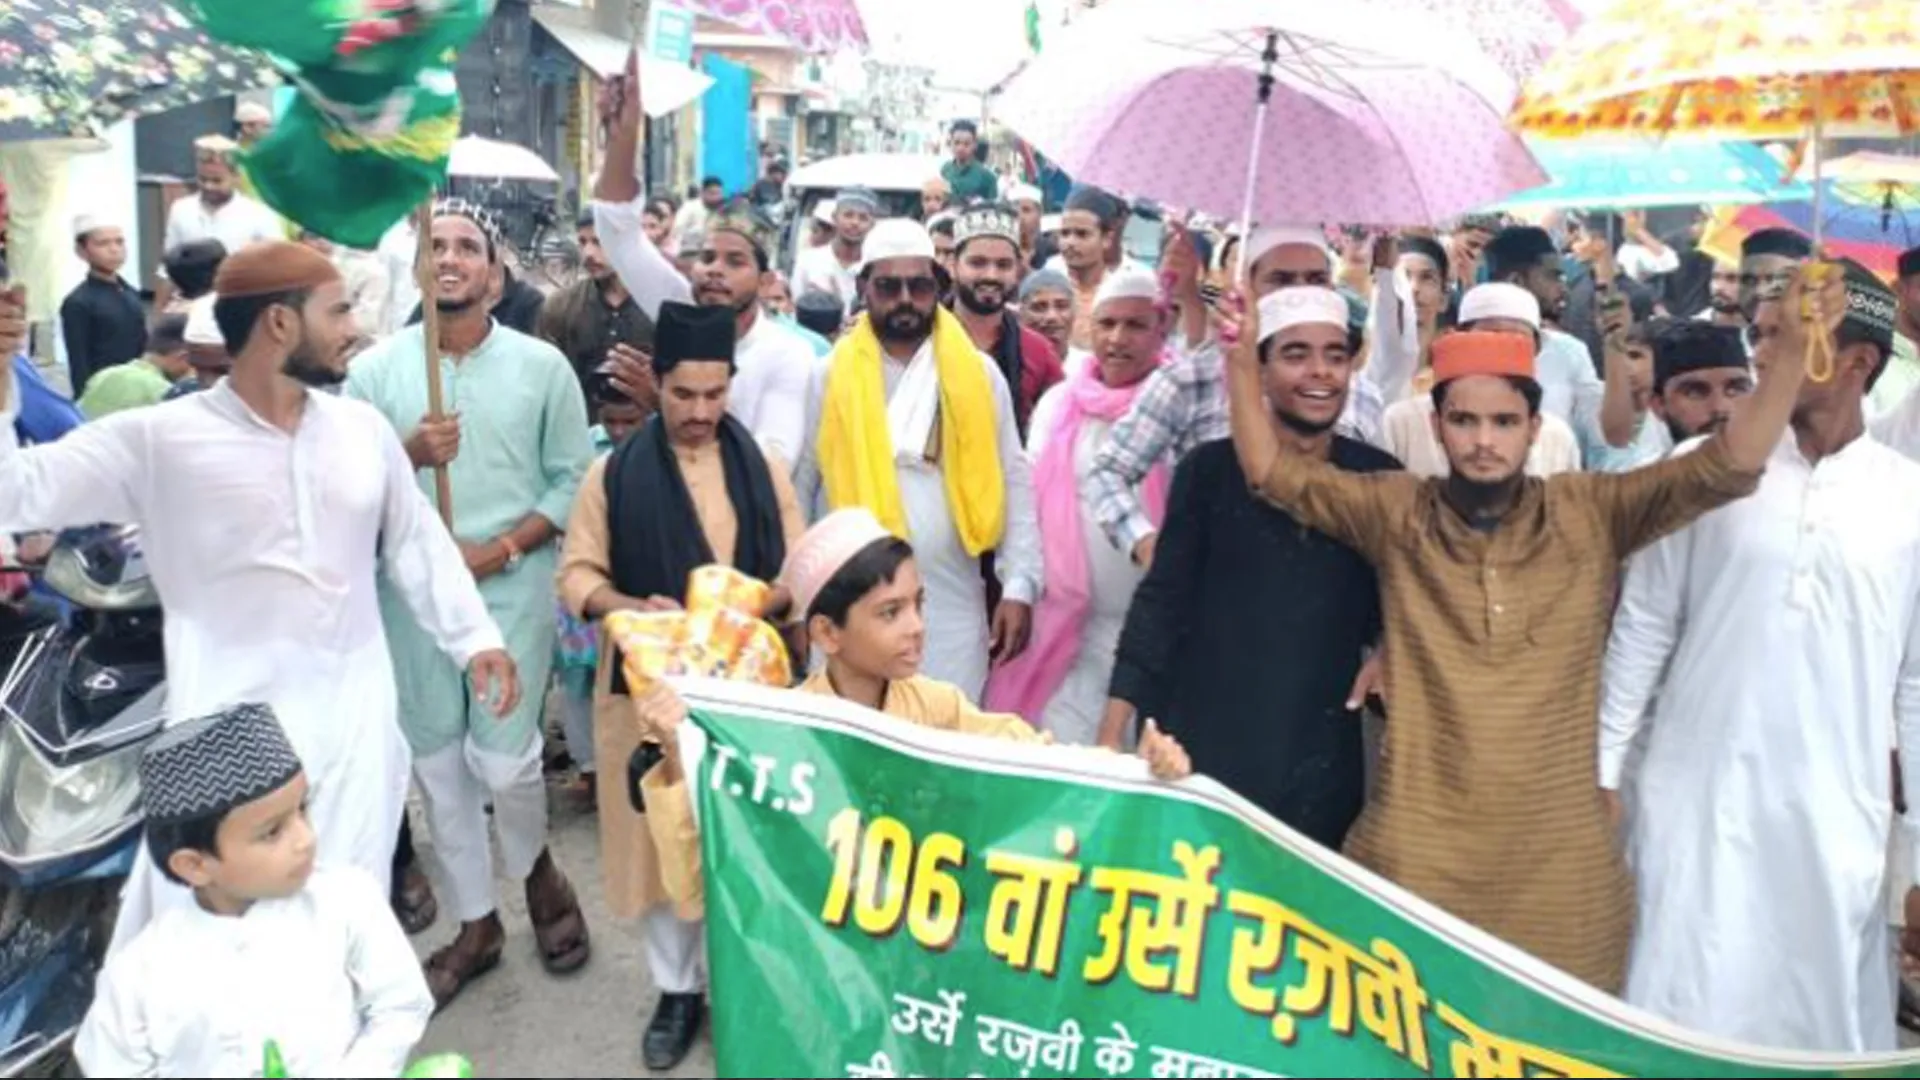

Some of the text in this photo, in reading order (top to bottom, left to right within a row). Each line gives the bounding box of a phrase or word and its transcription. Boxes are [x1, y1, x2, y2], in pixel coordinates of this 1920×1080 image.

[710, 741, 817, 815] T.T.S
[821, 807, 966, 949] 106
[984, 826, 1081, 975] वां
[1082, 840, 1219, 998] उर्से
[1227, 889, 1430, 1072] रज़वी
[891, 990, 965, 1046] उर्से
[1095, 1021, 1139, 1075] के
